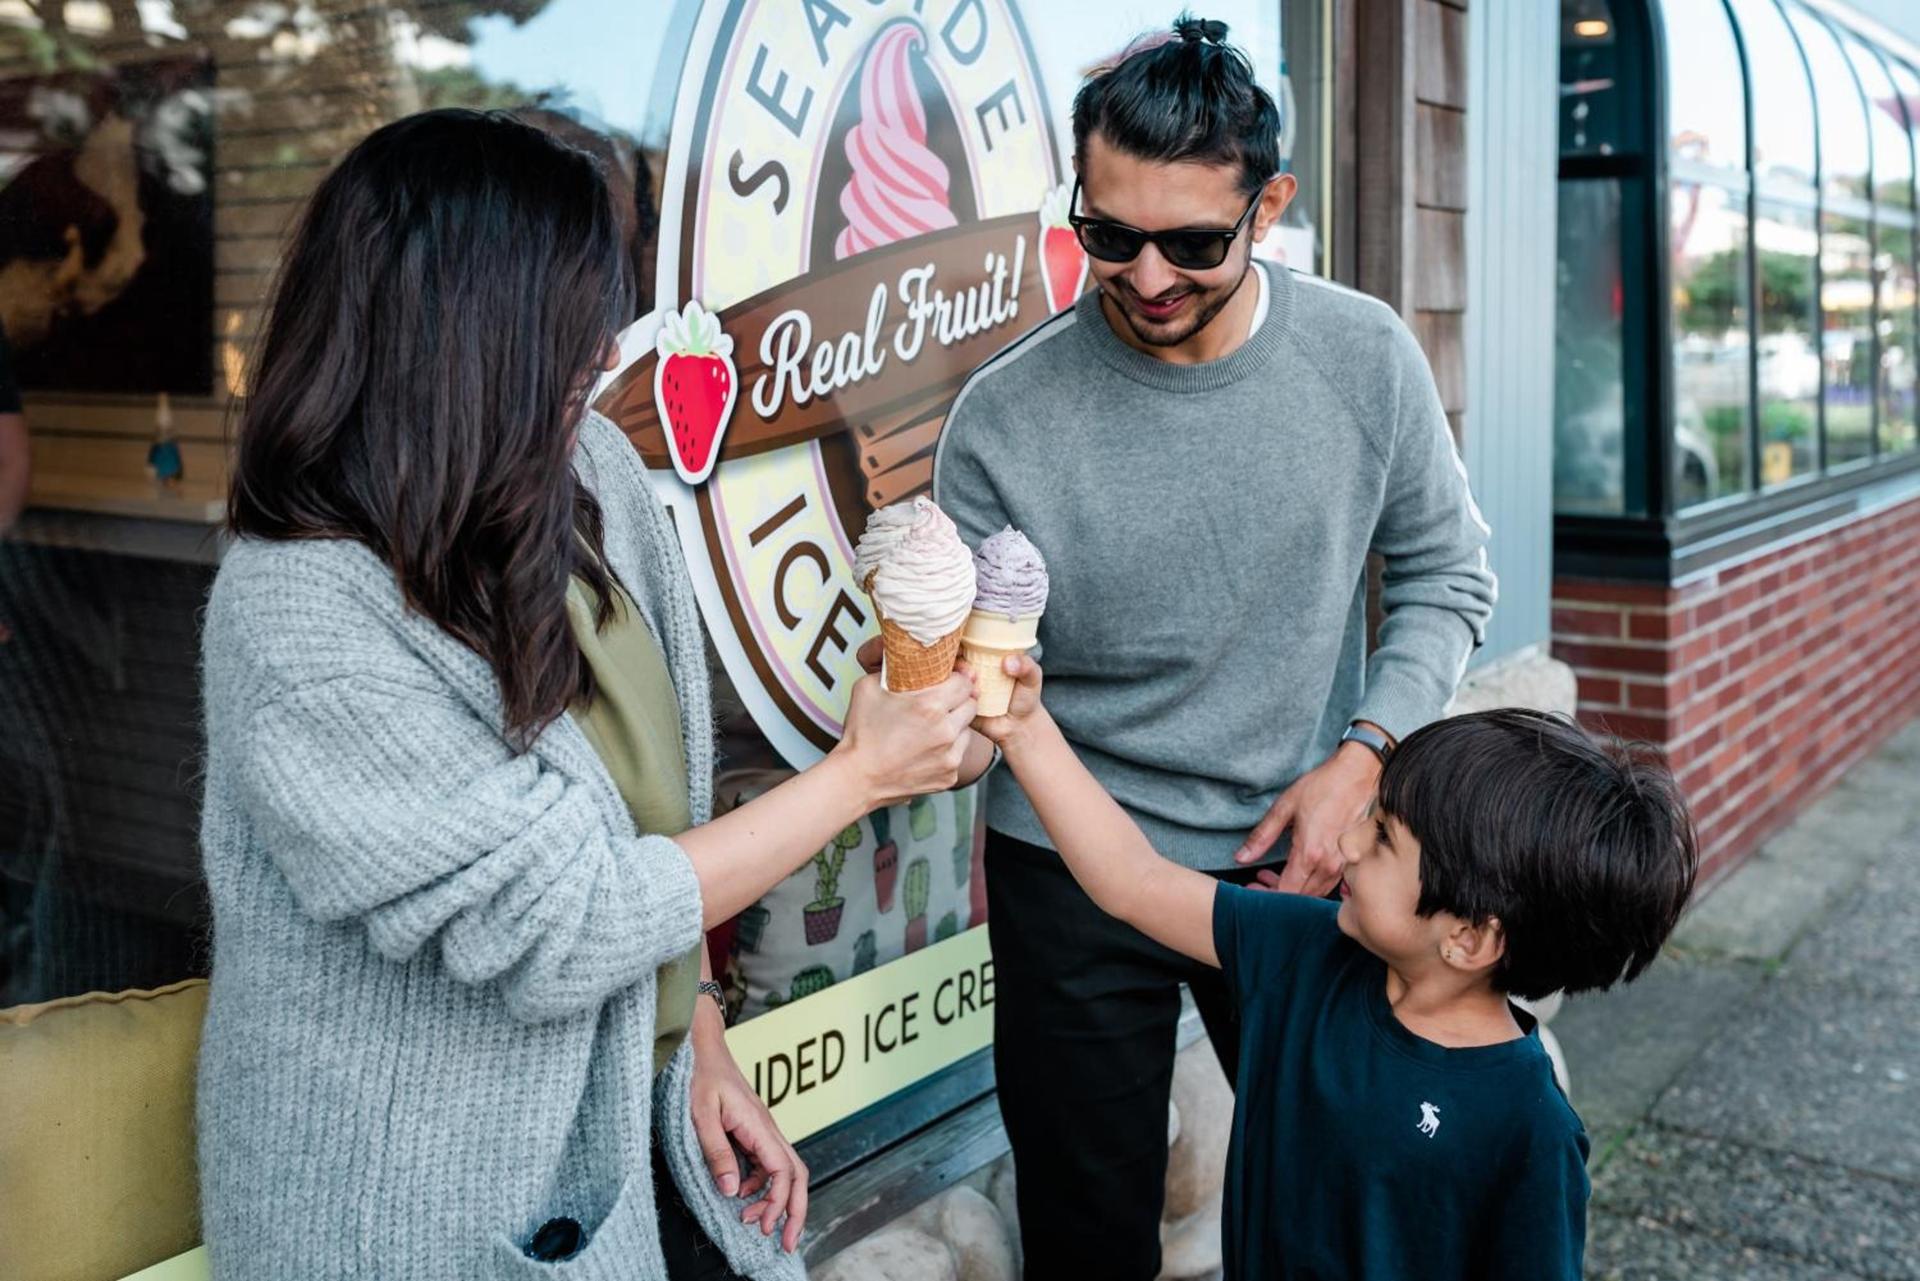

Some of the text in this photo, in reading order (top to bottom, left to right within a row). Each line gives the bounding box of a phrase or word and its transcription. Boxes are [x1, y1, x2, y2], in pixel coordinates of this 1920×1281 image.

[729, 0, 1026, 216] SEADE
[752, 234, 1026, 418] Real Fruit!
[749, 494, 866, 691] ICE
[755, 960, 995, 1108] DED ICE CRE
